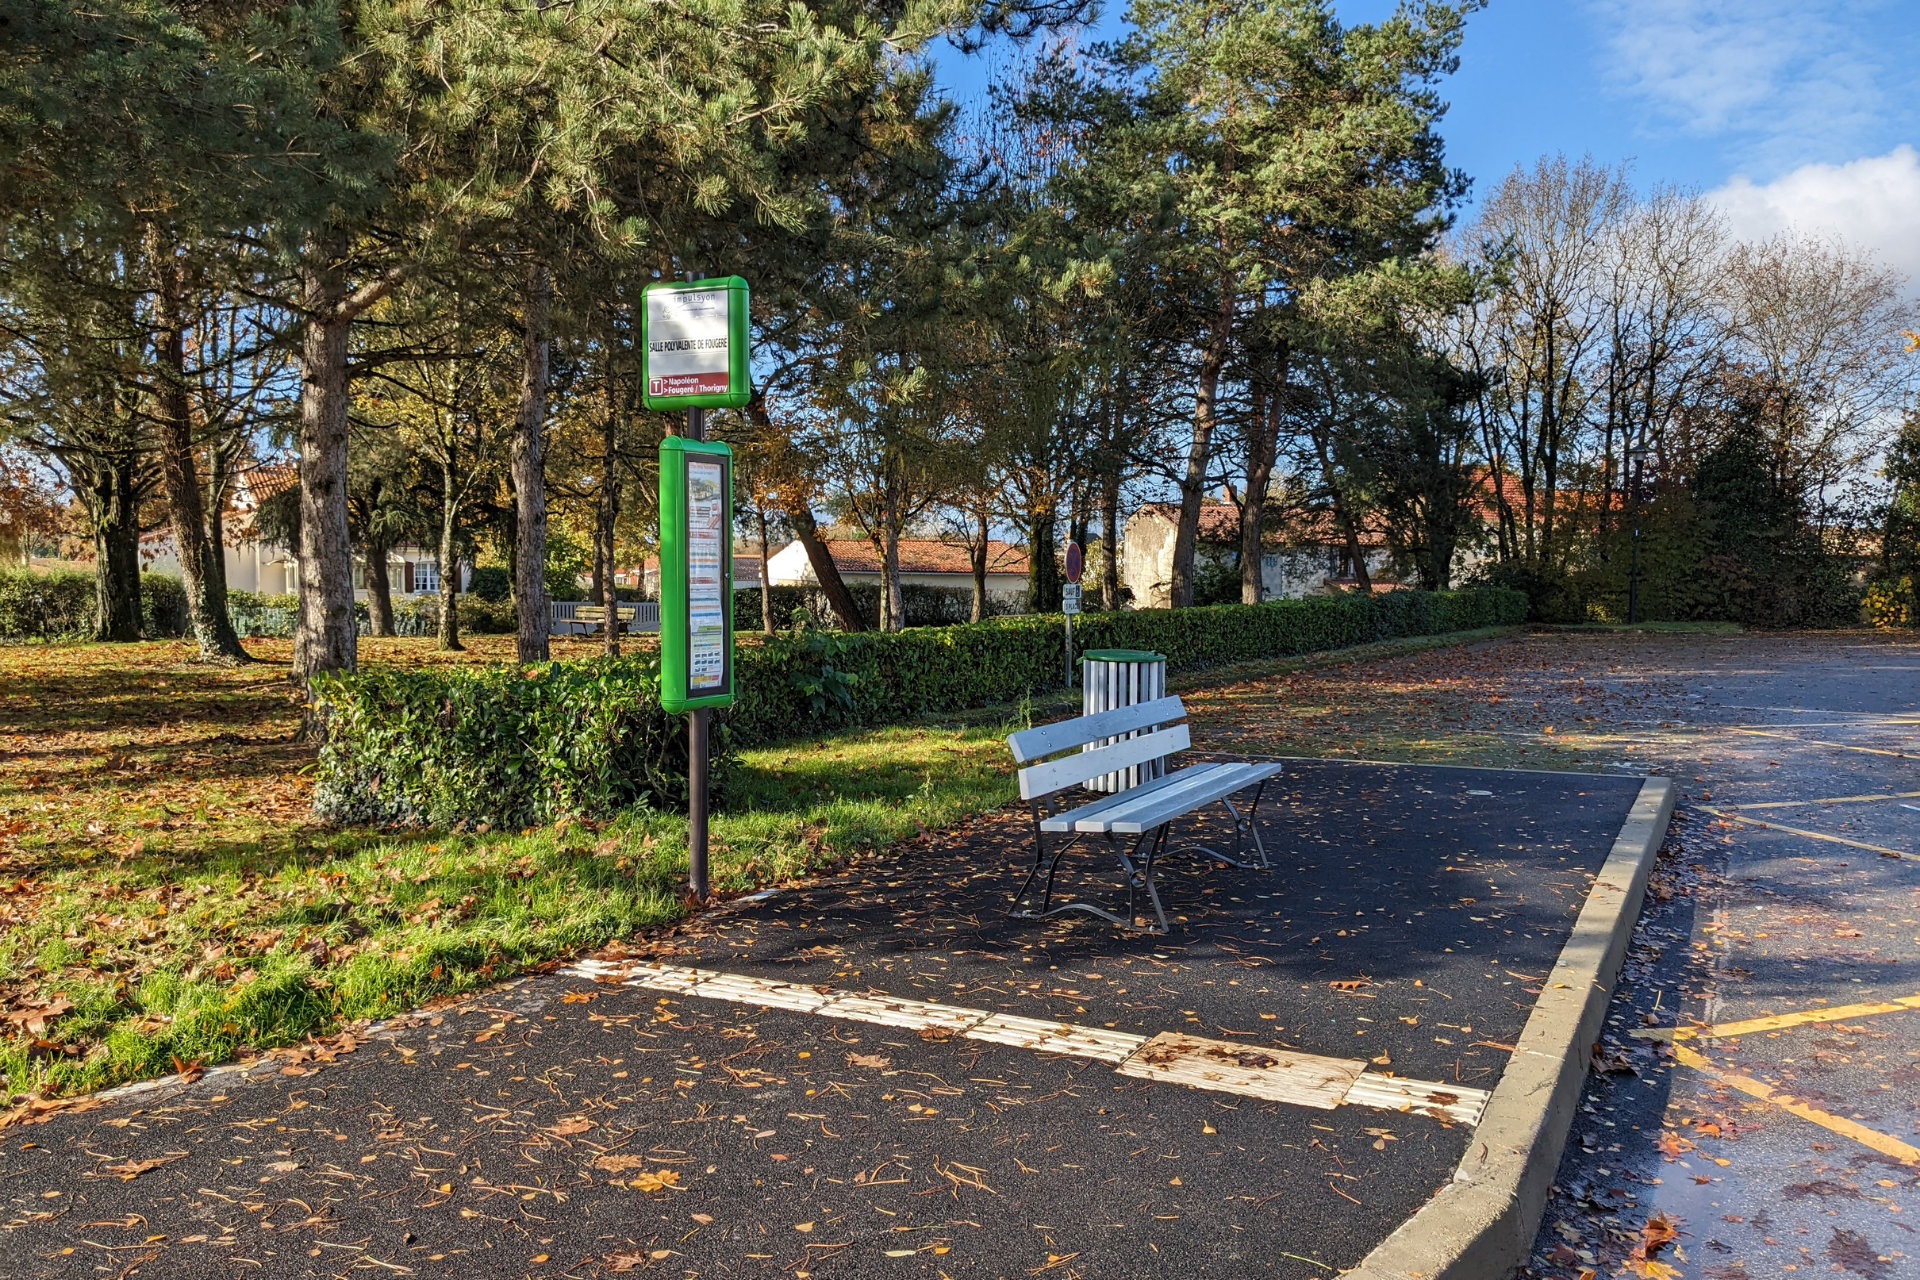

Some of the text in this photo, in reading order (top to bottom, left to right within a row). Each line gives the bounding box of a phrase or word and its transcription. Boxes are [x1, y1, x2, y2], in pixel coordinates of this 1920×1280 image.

[673, 293, 715, 304] impulsyon
[649, 341, 663, 353] SALLE
[664, 339, 696, 352] POLYVALENTE
[697, 339, 704, 349] DE
[652, 381, 660, 392] T
[668, 377, 699, 386] Napoléon
[668, 385, 694, 395] Fougeré
[699, 384, 728, 394] Thorigny
[1065, 587, 1075, 596] SAUF
